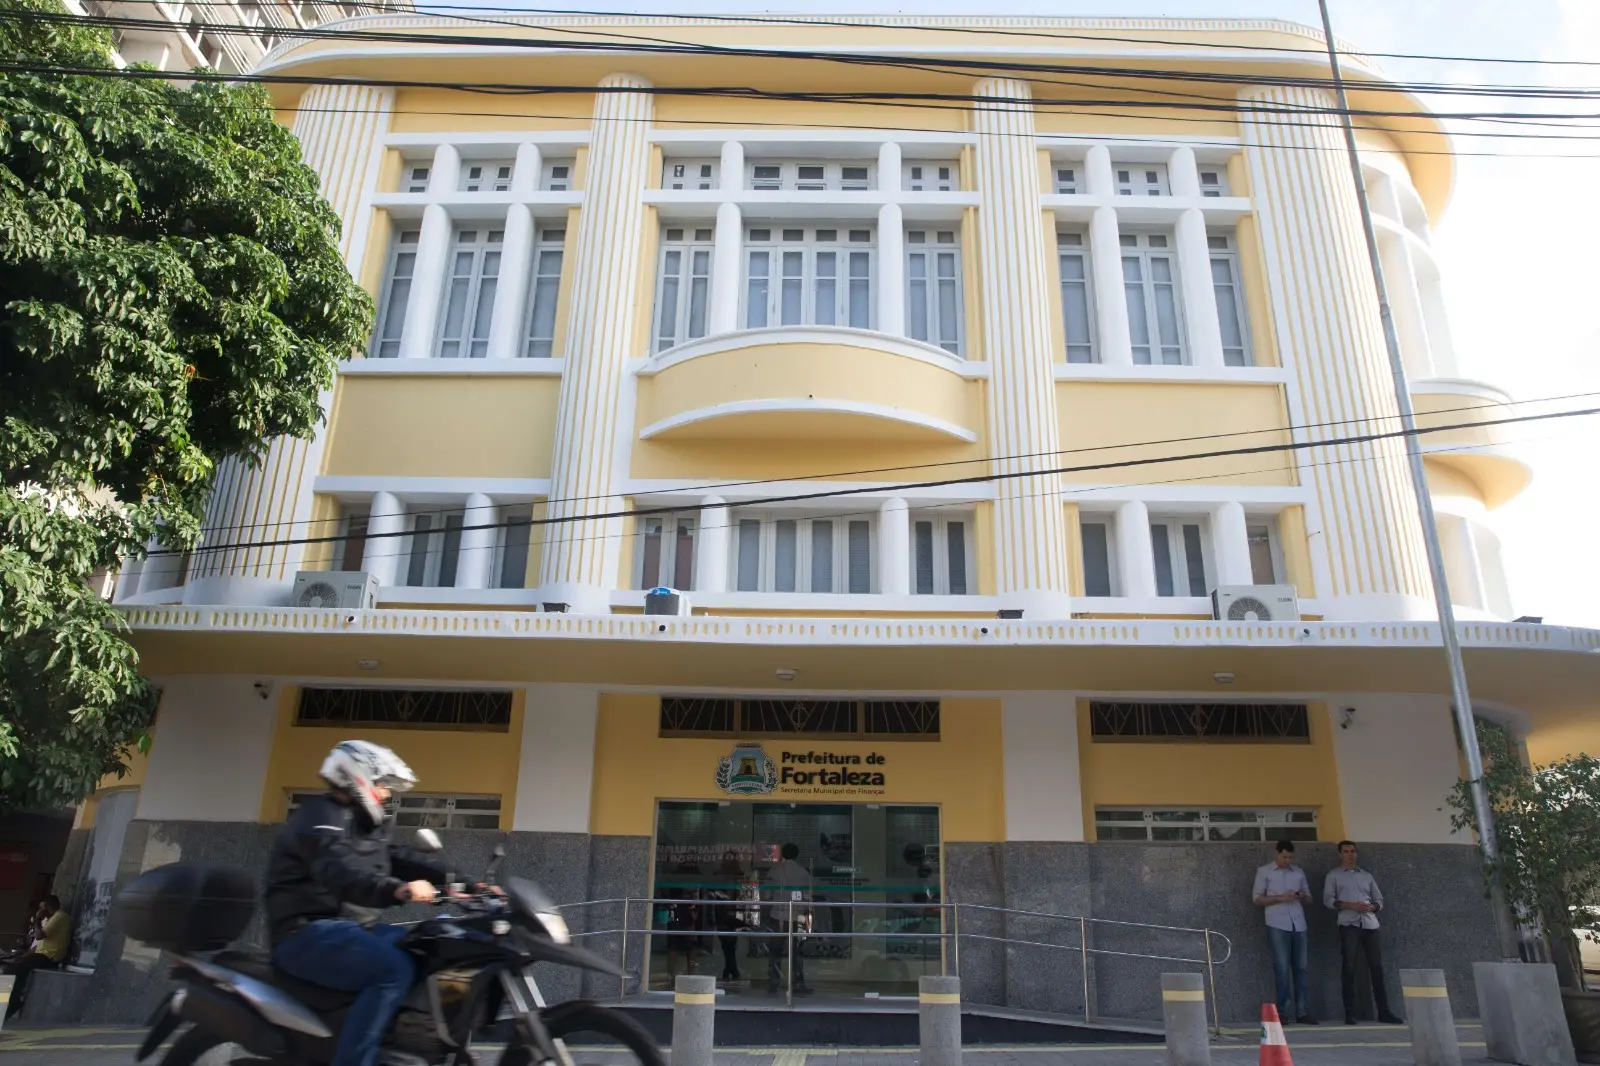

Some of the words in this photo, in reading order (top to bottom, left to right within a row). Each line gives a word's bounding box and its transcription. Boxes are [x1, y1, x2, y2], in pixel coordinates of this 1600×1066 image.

[782, 751, 861, 765] Prefeitura
[865, 752, 886, 765] de
[781, 766, 885, 785] Fortaleza
[813, 787, 845, 795] Municipal
[858, 788, 885, 796] Finanças
